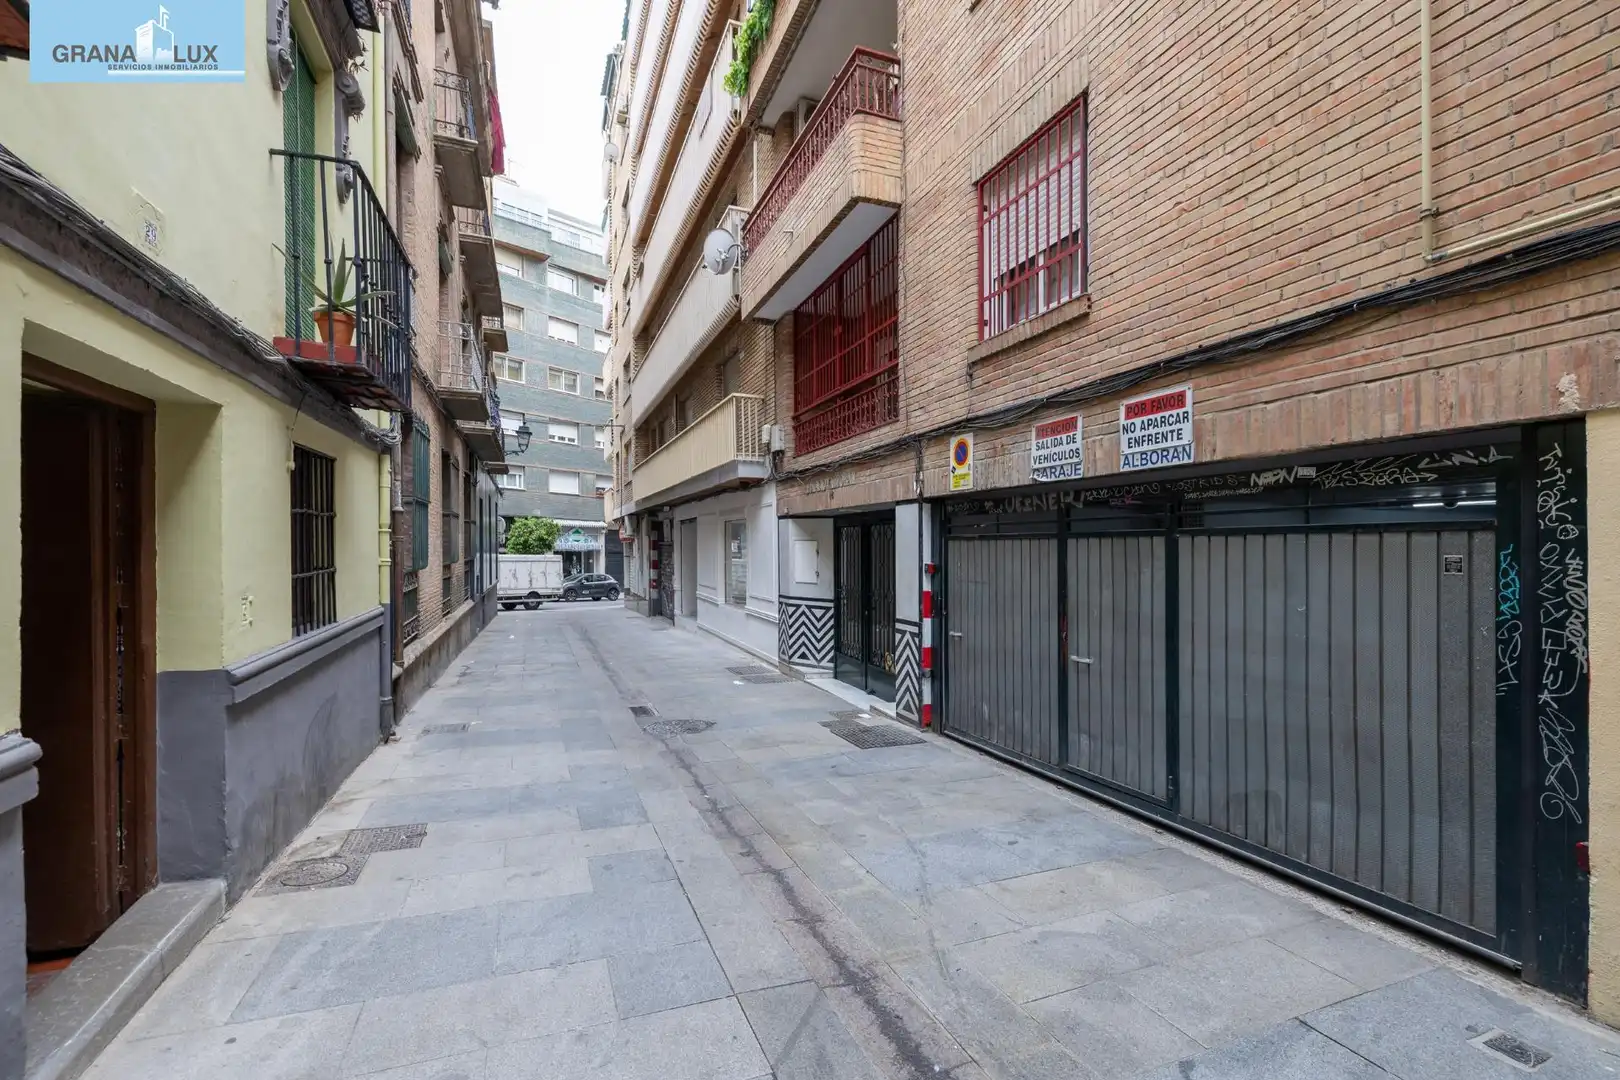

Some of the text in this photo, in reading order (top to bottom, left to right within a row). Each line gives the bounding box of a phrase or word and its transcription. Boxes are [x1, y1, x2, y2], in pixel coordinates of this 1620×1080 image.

[1126, 394, 1185, 417] POR FAVOR
[1122, 411, 1190, 435] NO APARCAR
[1035, 433, 1077, 452] SALIDA DE
[1127, 428, 1184, 449] ENFRENTE
[1032, 447, 1081, 466] VEHÍCULOS
[1121, 445, 1192, 470] ALBORAN
[1032, 463, 1082, 480] GARAJE
